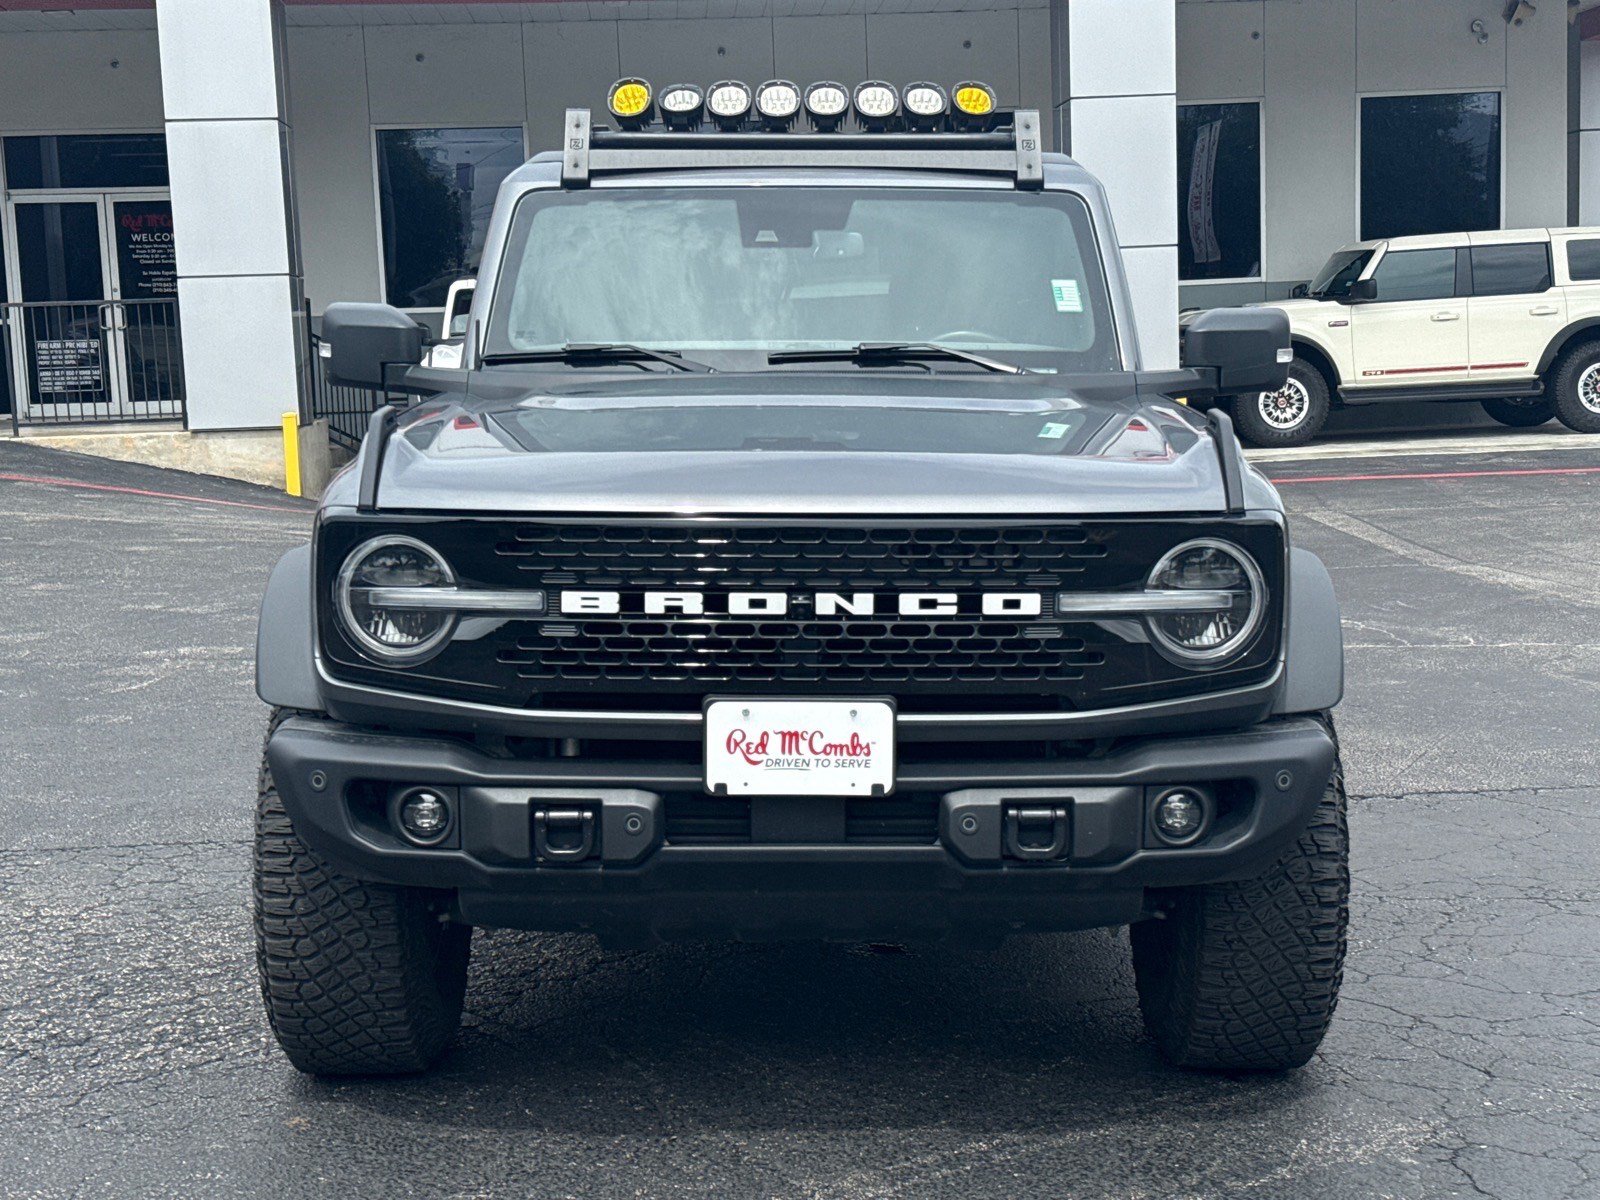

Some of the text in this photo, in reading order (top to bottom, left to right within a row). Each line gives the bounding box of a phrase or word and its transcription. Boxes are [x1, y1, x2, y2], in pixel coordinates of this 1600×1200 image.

[560, 591, 1042, 616] BRONCO
[725, 728, 872, 766] Red McCombs
[765, 757, 872, 768] DRIVEN TO SERVE
